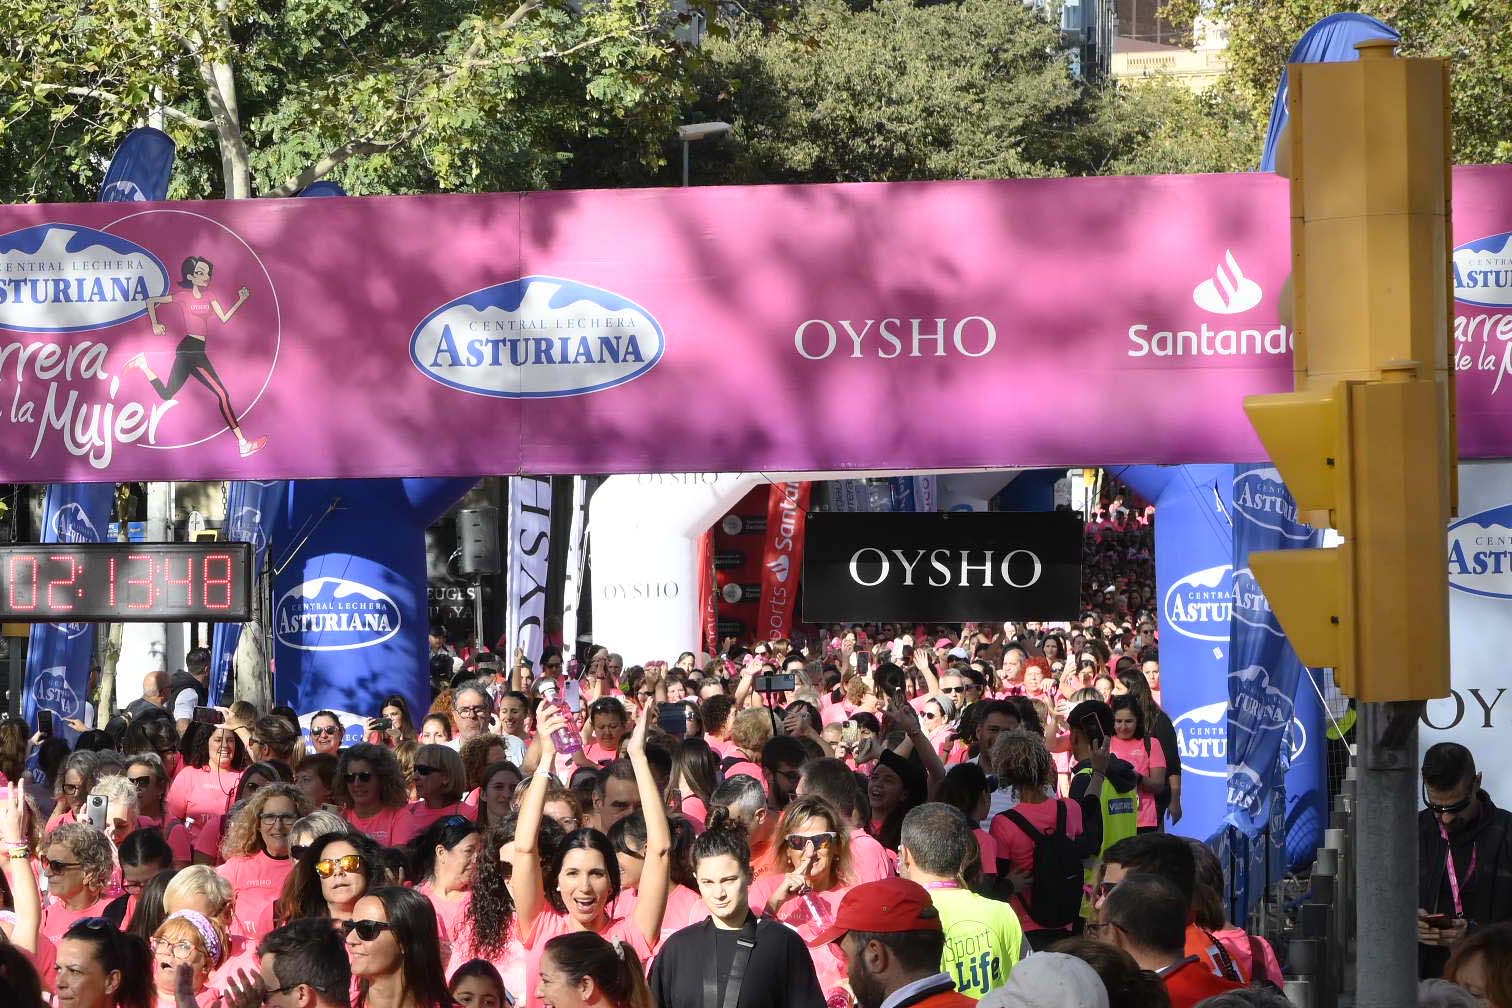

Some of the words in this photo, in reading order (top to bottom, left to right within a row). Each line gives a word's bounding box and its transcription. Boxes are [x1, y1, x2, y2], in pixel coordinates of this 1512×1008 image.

[71, 260, 145, 271] LECHERA
[469, 319, 548, 331] CENTRAL
[555, 316, 637, 329] LECHERA
[795, 315, 997, 360] OYSHO
[1127, 323, 1294, 358] Santand
[429, 325, 645, 369] ASTURIANA
[1478, 343, 1496, 370] la
[10, 384, 35, 424] la
[30, 374, 179, 469] Mujer
[9, 554, 231, 609] 02:13:48
[848, 547, 1042, 588] OYSHO
[279, 607, 392, 635] ASTURIANA
[338, 602, 388, 610] LECHERA
[1190, 728, 1227, 736] CENTR
[945, 929, 992, 963] Sport
[956, 951, 1000, 994] Life
